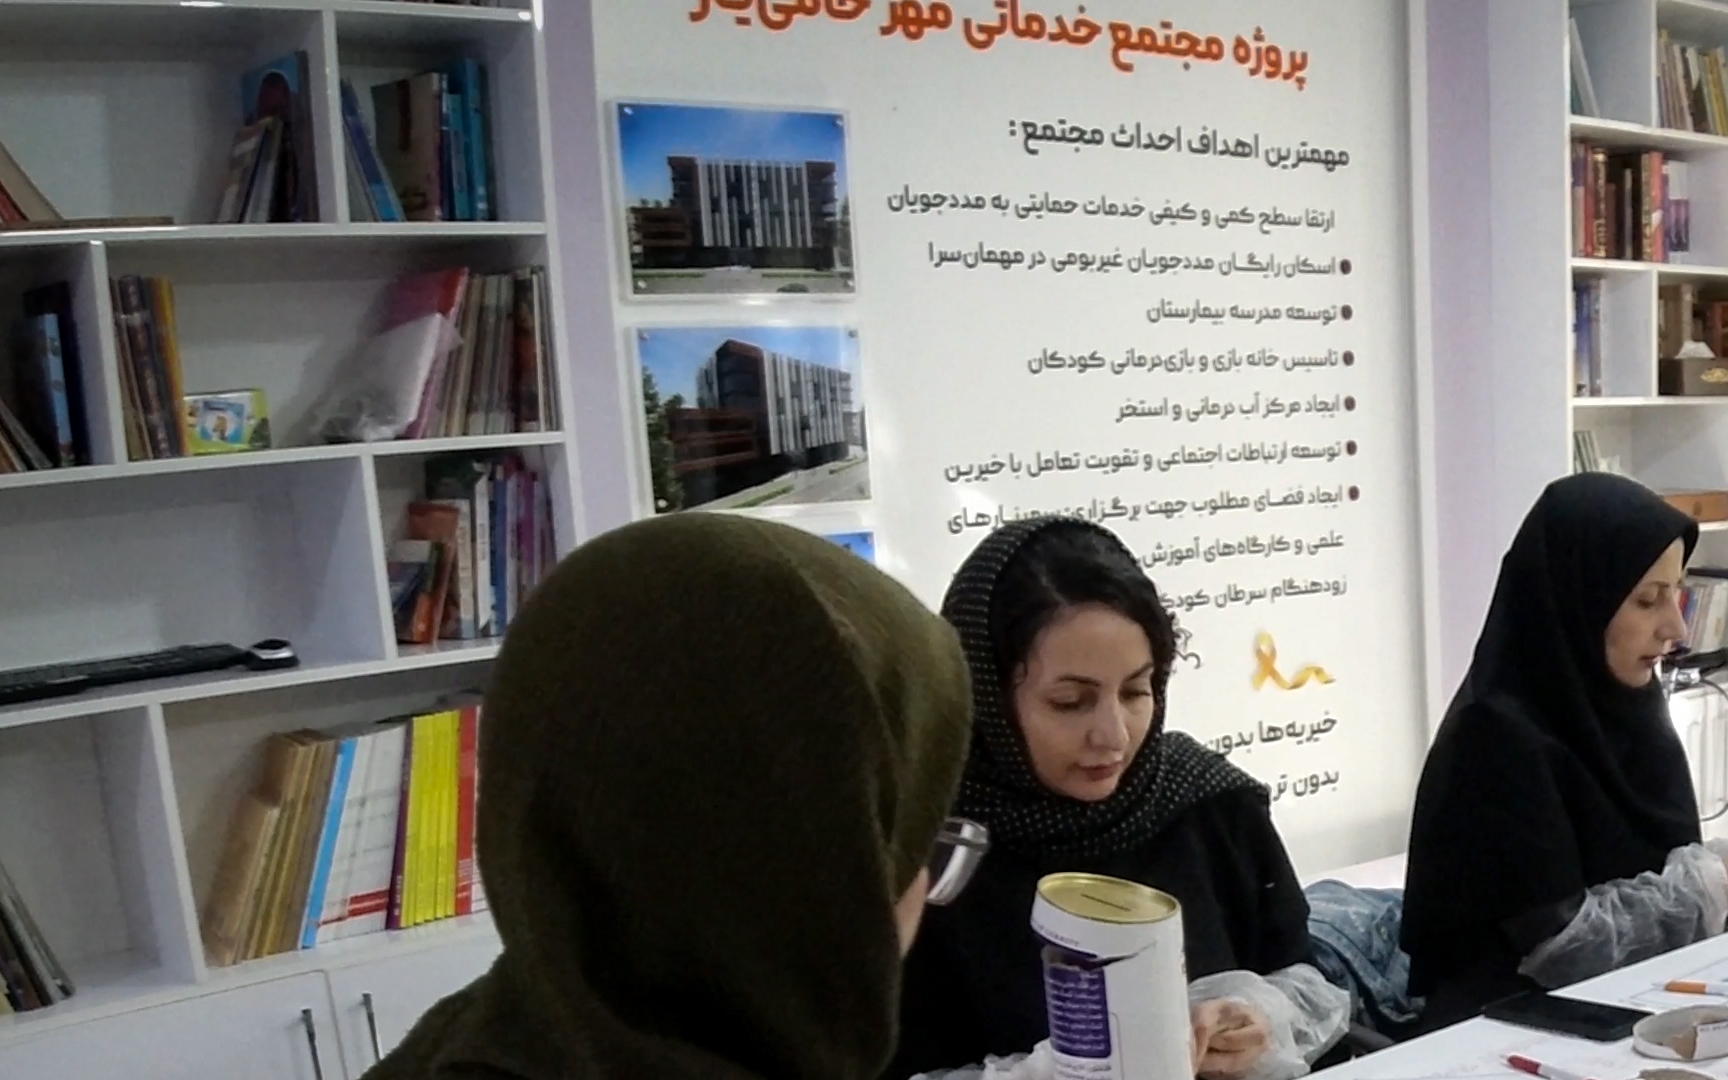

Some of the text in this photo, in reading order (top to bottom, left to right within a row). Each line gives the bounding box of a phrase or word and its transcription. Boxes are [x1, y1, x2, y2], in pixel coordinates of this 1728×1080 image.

[879, 0, 952, 40] مهر
[963, 0, 1103, 50] خدماتی
[1108, 20, 1224, 72] مجتمع
[1233, 26, 1308, 91] پروژه
[1111, 121, 1182, 153] احداث
[1187, 126, 1260, 160] اهداف
[1264, 142, 1350, 172] مهمترین
[887, 183, 1335, 235] ارتقا سطح کمی و کیفی خدمات حمایتی به مددجویان
[1027, 249, 1047, 270] در
[1050, 246, 1124, 273] غیربومی
[1127, 247, 1215, 276] مددجویان
[1284, 255, 1336, 278] اسکان
[1146, 298, 1337, 326] توسعه مدرسه بیمارستان
[1027, 348, 1106, 375] کودکان
[1199, 352, 1209, 372] و
[1212, 349, 1243, 373] بازی
[1246, 347, 1280, 368] خانه
[1283, 349, 1339, 373] تاسیس
[1115, 392, 1340, 423] ایجاد مرکز آب درمانی و استخر
[944, 441, 1342, 483] توسعه ارتباطات اجتماعی و تقویت تعامل با خیرین
[1145, 499, 1188, 519] جهت
[1191, 490, 1250, 518] مطلوب
[1254, 485, 1305, 512] فضای
[1307, 484, 1343, 508] ایجاد
[1294, 539, 1303, 555] و
[1307, 530, 1344, 556] علمی
[1215, 583, 1267, 608] سرطان
[1271, 575, 1347, 604] زودهنگام
[1292, 770, 1340, 796] بدون
